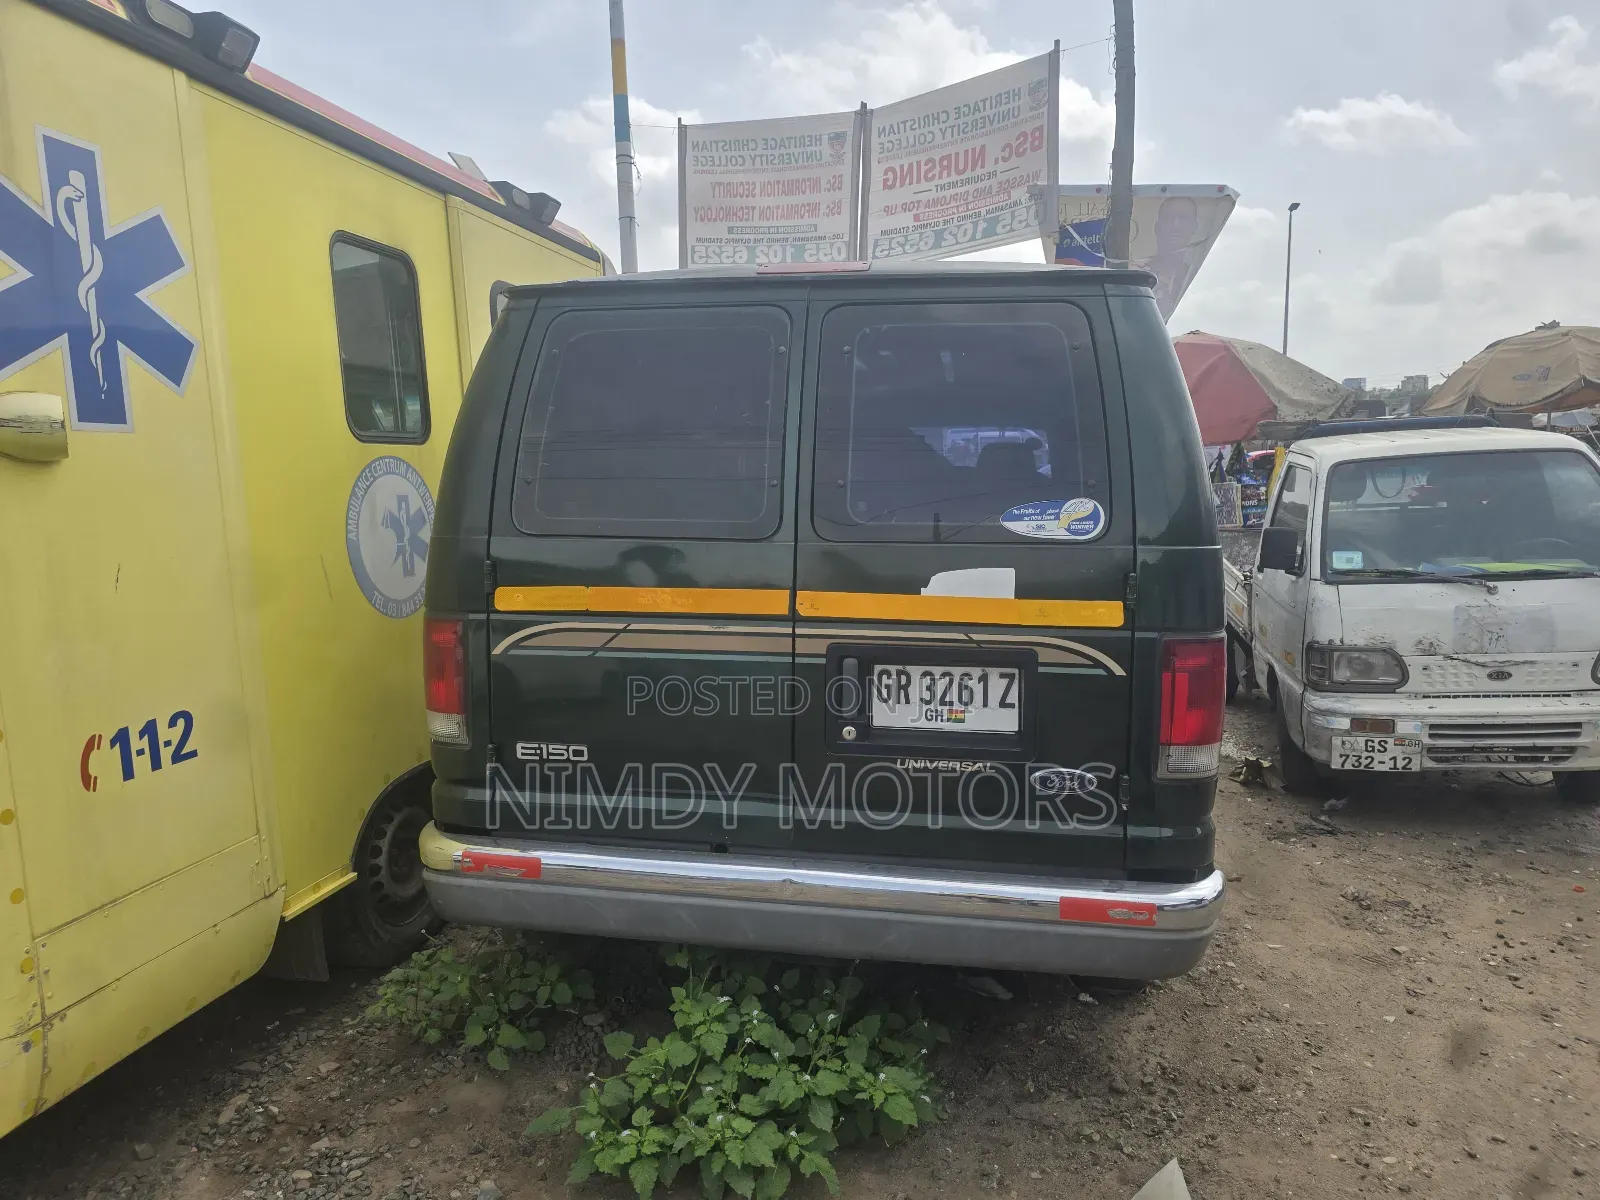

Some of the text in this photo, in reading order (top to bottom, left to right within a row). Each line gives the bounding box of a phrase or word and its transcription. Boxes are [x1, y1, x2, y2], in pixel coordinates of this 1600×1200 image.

[347, 468, 372, 541] AMBULANCE
[371, 458, 407, 477] CENTRUM
[372, 590, 386, 613] TEL.
[386, 601, 397, 617] 03
[401, 599, 415, 617] 844
[877, 668, 1016, 709] GR 3261 Z
[925, 708, 944, 723] GH
[109, 709, 198, 782] 1-1-2
[1364, 739, 1388, 753] GS
[1407, 740, 1420, 748] GH
[897, 758, 996, 773] UNIVERSAL
[1339, 754, 1413, 771] 732-12
[1046, 773, 1081, 789] Ford
